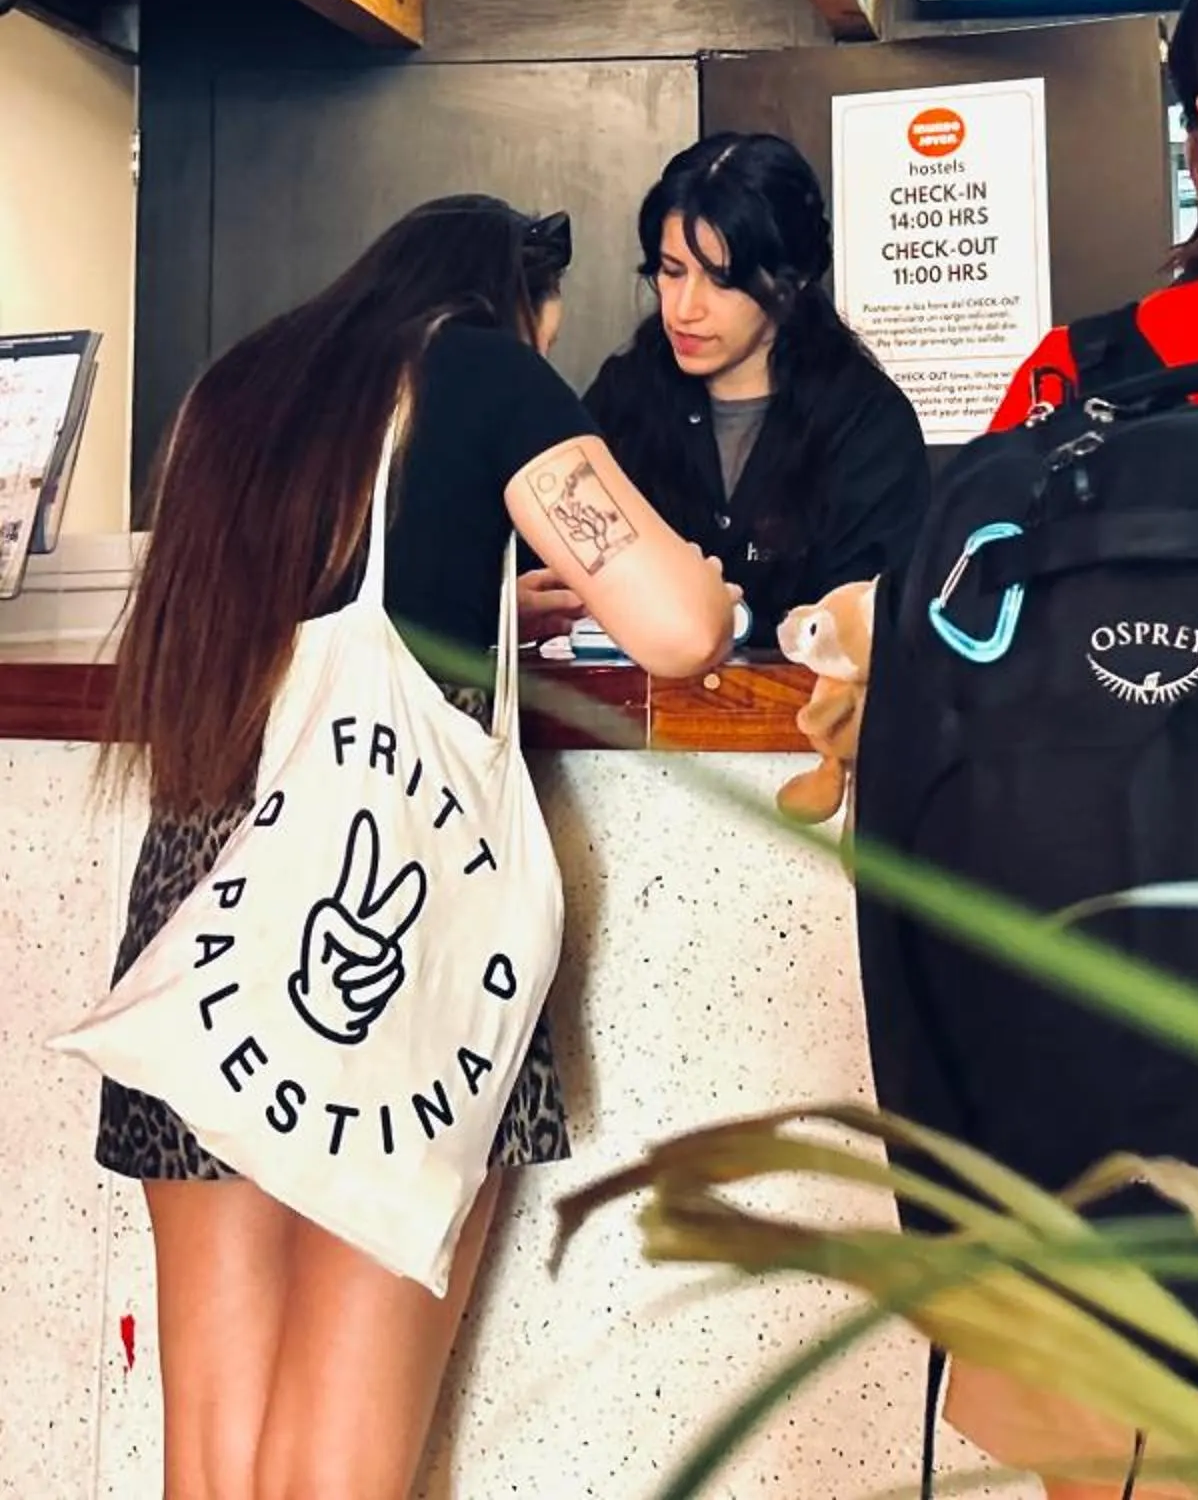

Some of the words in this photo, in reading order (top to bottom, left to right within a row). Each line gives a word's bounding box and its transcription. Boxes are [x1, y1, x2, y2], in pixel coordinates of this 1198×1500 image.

[909, 158, 966, 176] hostels
[890, 181, 987, 205] CHECK-IN
[890, 209, 943, 230] 14:00
[948, 206, 989, 226] HRS
[881, 236, 999, 261] CHECK-OUT
[893, 265, 942, 285] 11:00
[947, 262, 988, 282] HRS
[331, 716, 497, 875] FRITT
[193, 877, 493, 1155] PALESTINA
